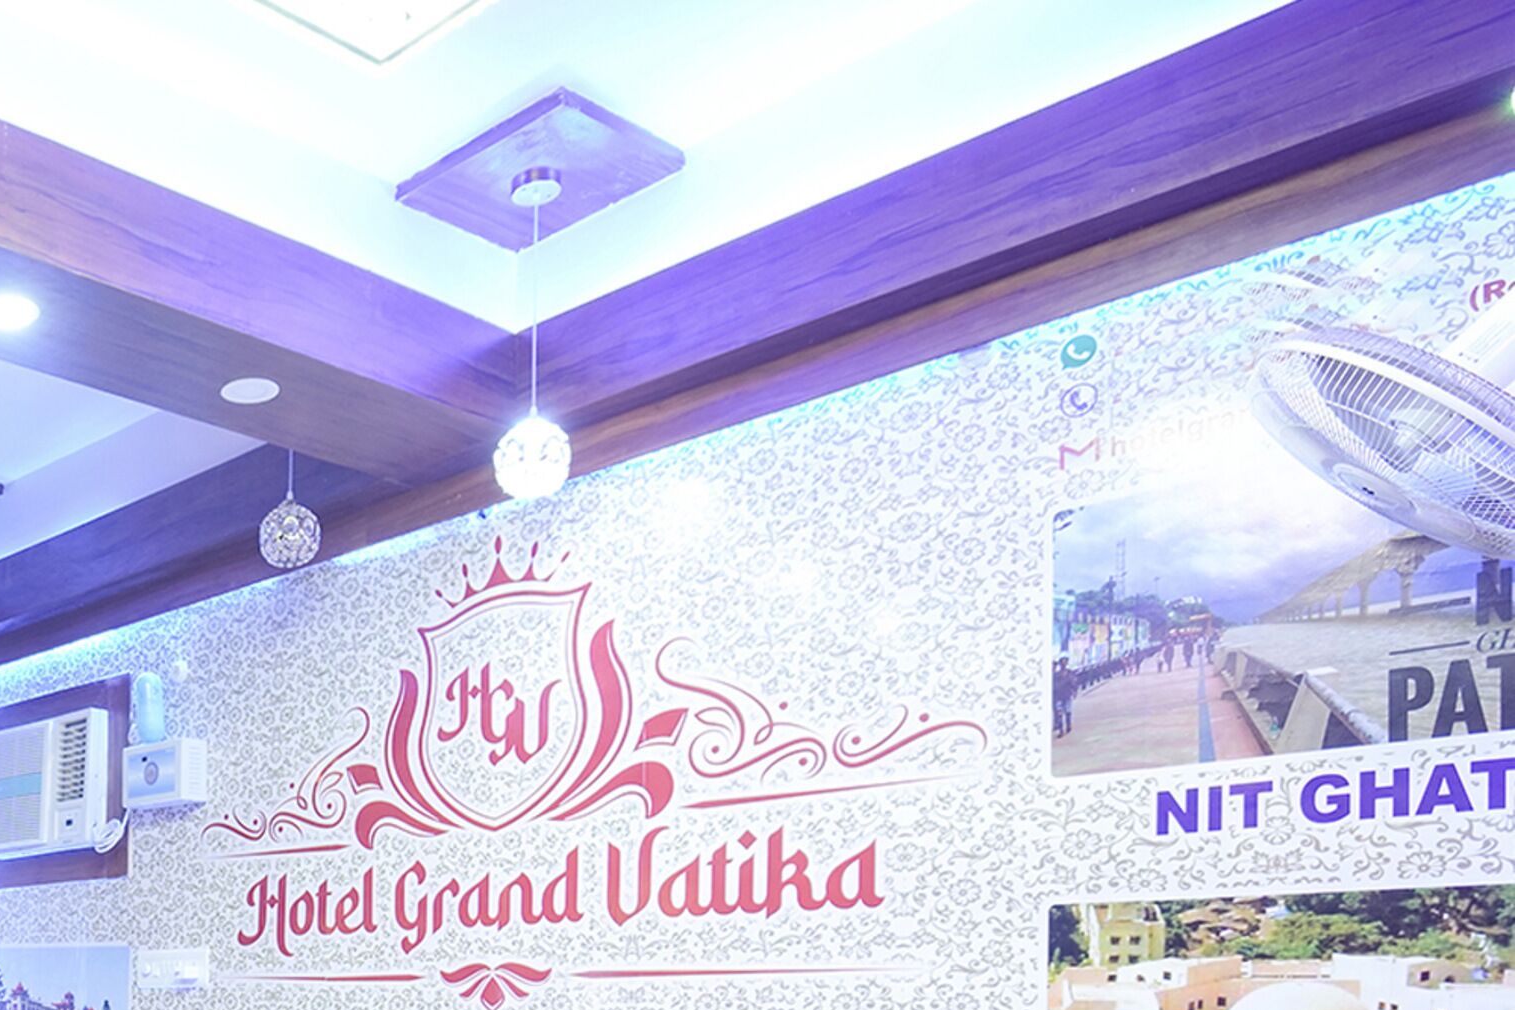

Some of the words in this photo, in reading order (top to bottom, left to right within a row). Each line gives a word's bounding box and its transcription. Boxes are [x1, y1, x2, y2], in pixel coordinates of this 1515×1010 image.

[1156, 780, 1273, 836] NIT
[1299, 757, 1515, 824] GHAT
[237, 866, 377, 957] Hotel
[394, 845, 584, 954] Grand
[606, 825, 886, 926] Vatika
